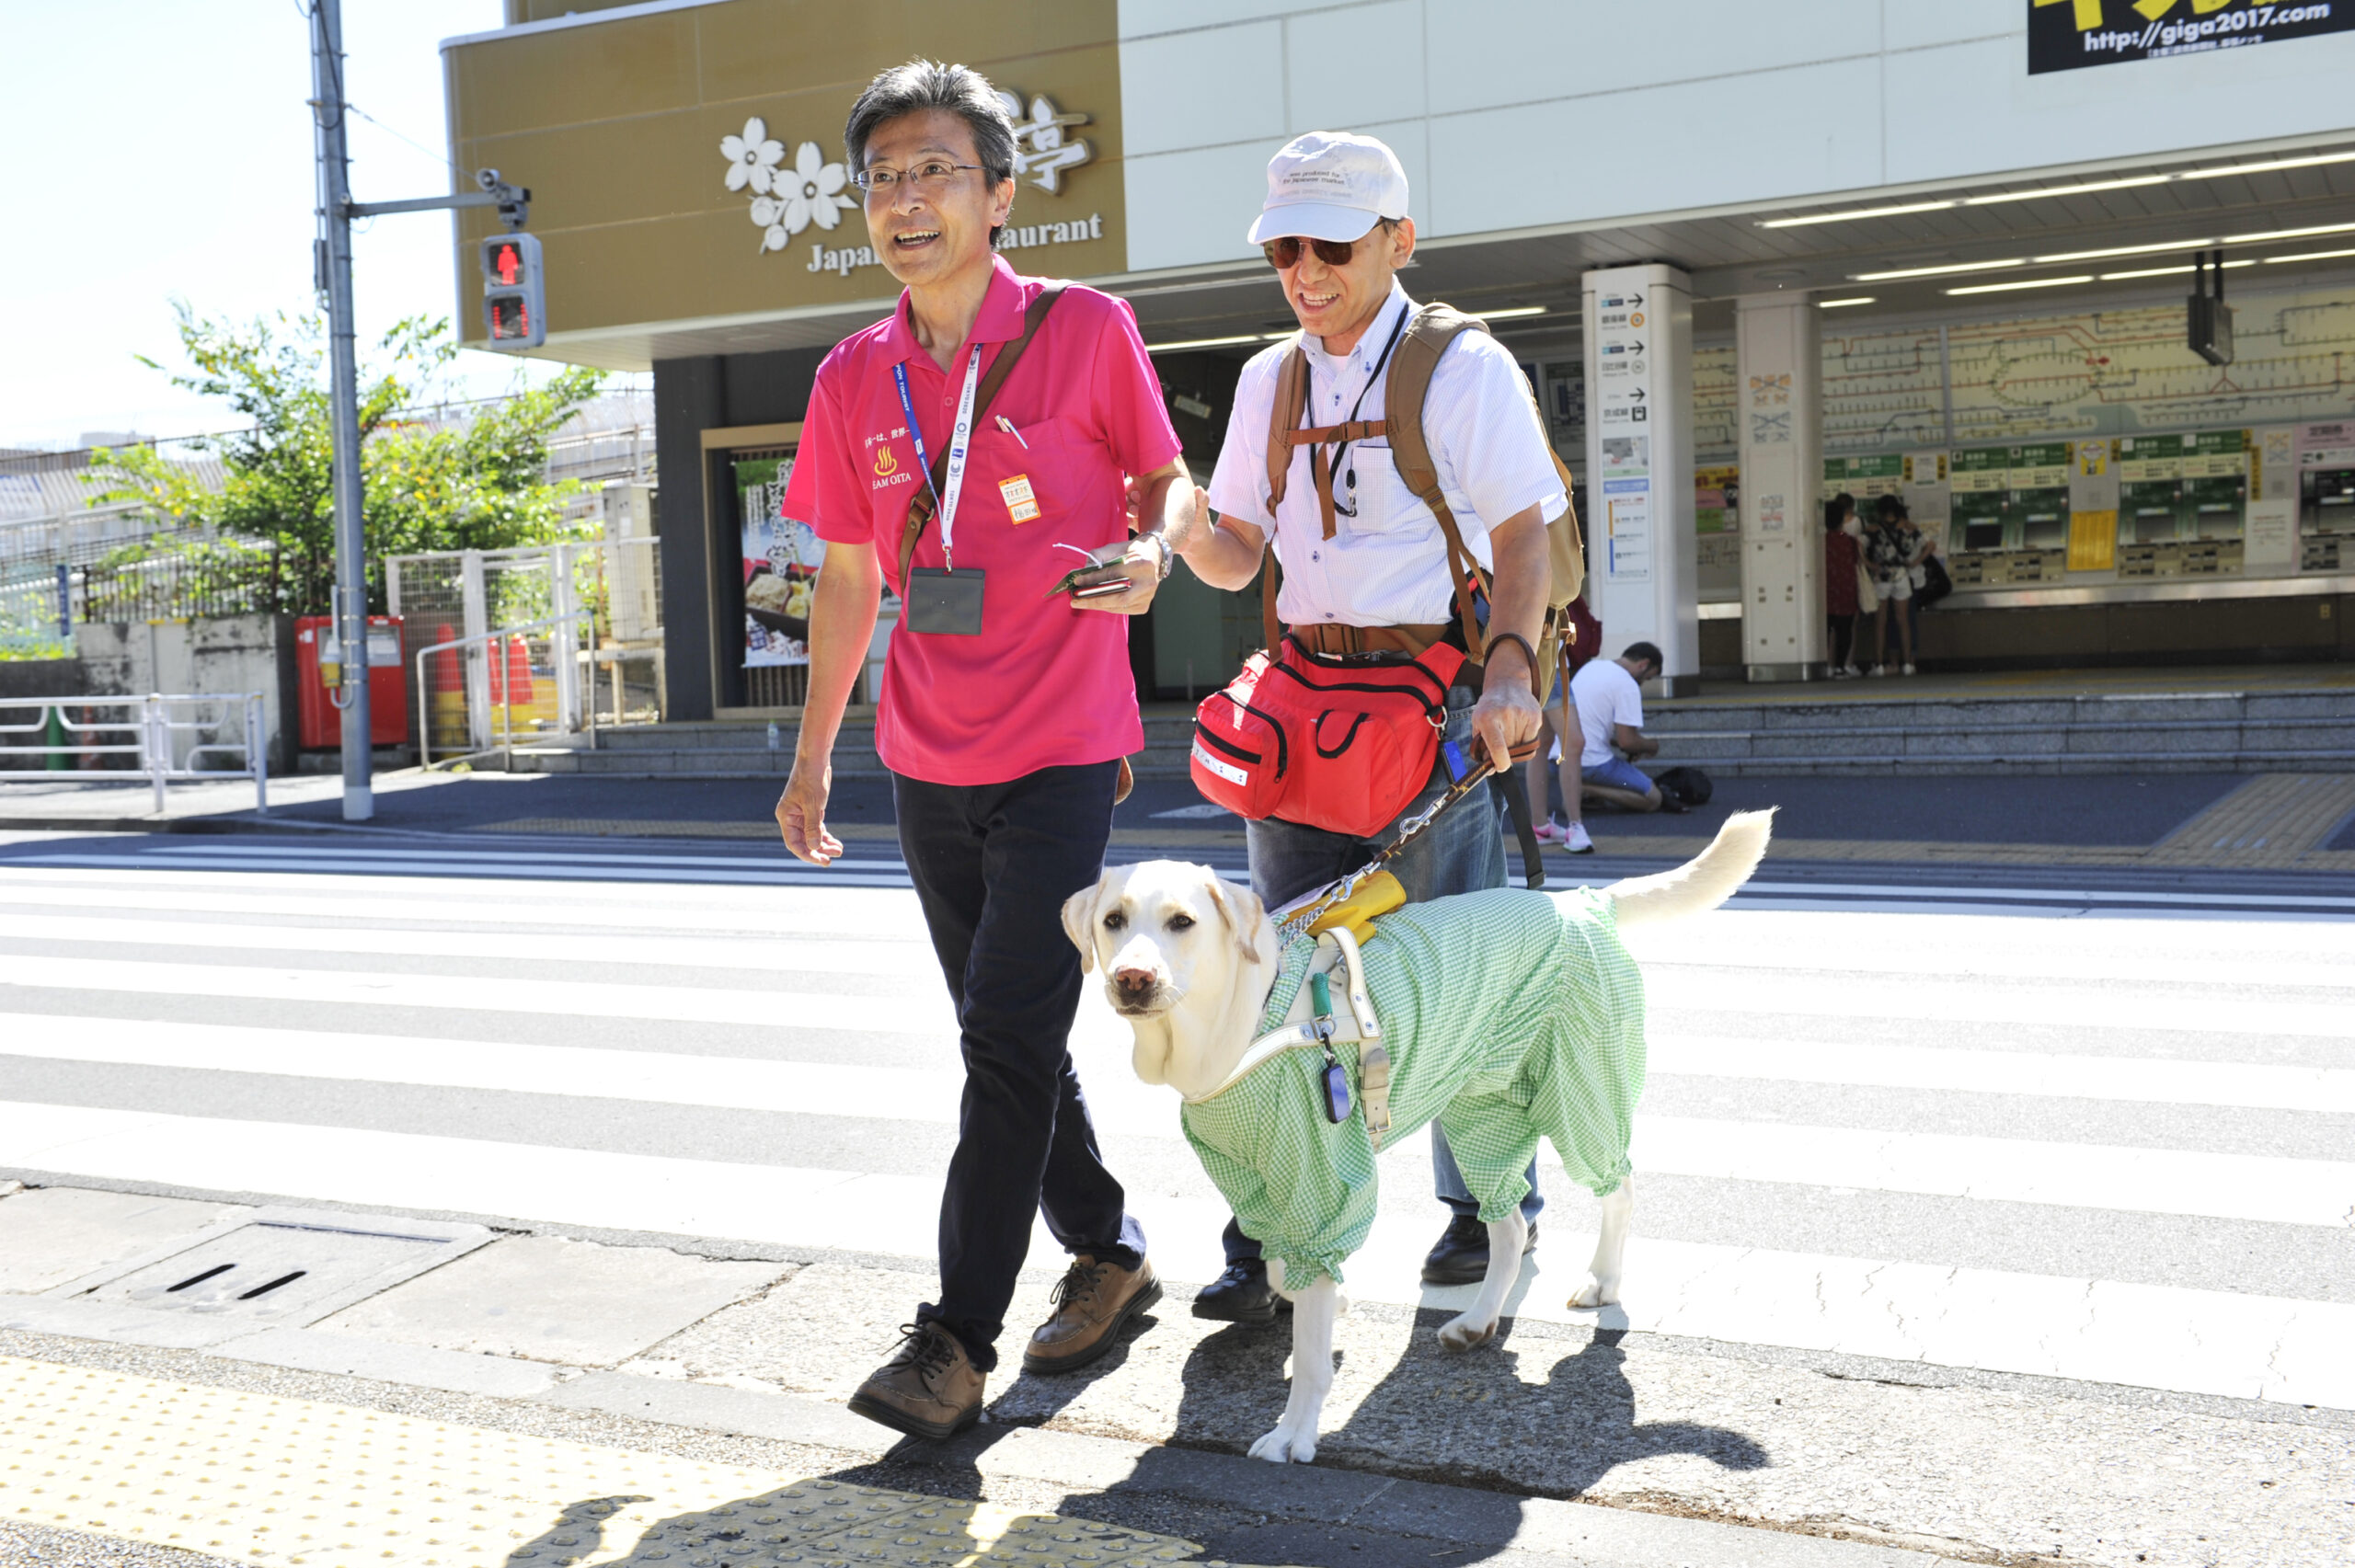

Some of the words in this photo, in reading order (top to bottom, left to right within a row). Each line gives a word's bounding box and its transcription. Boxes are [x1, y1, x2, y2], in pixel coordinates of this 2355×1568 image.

[2084, 3, 2331, 52] http://giga2017.com
[1000, 212, 1103, 249] aurant
[872, 477, 890, 490] EAM
[890, 472, 912, 485] OITA
